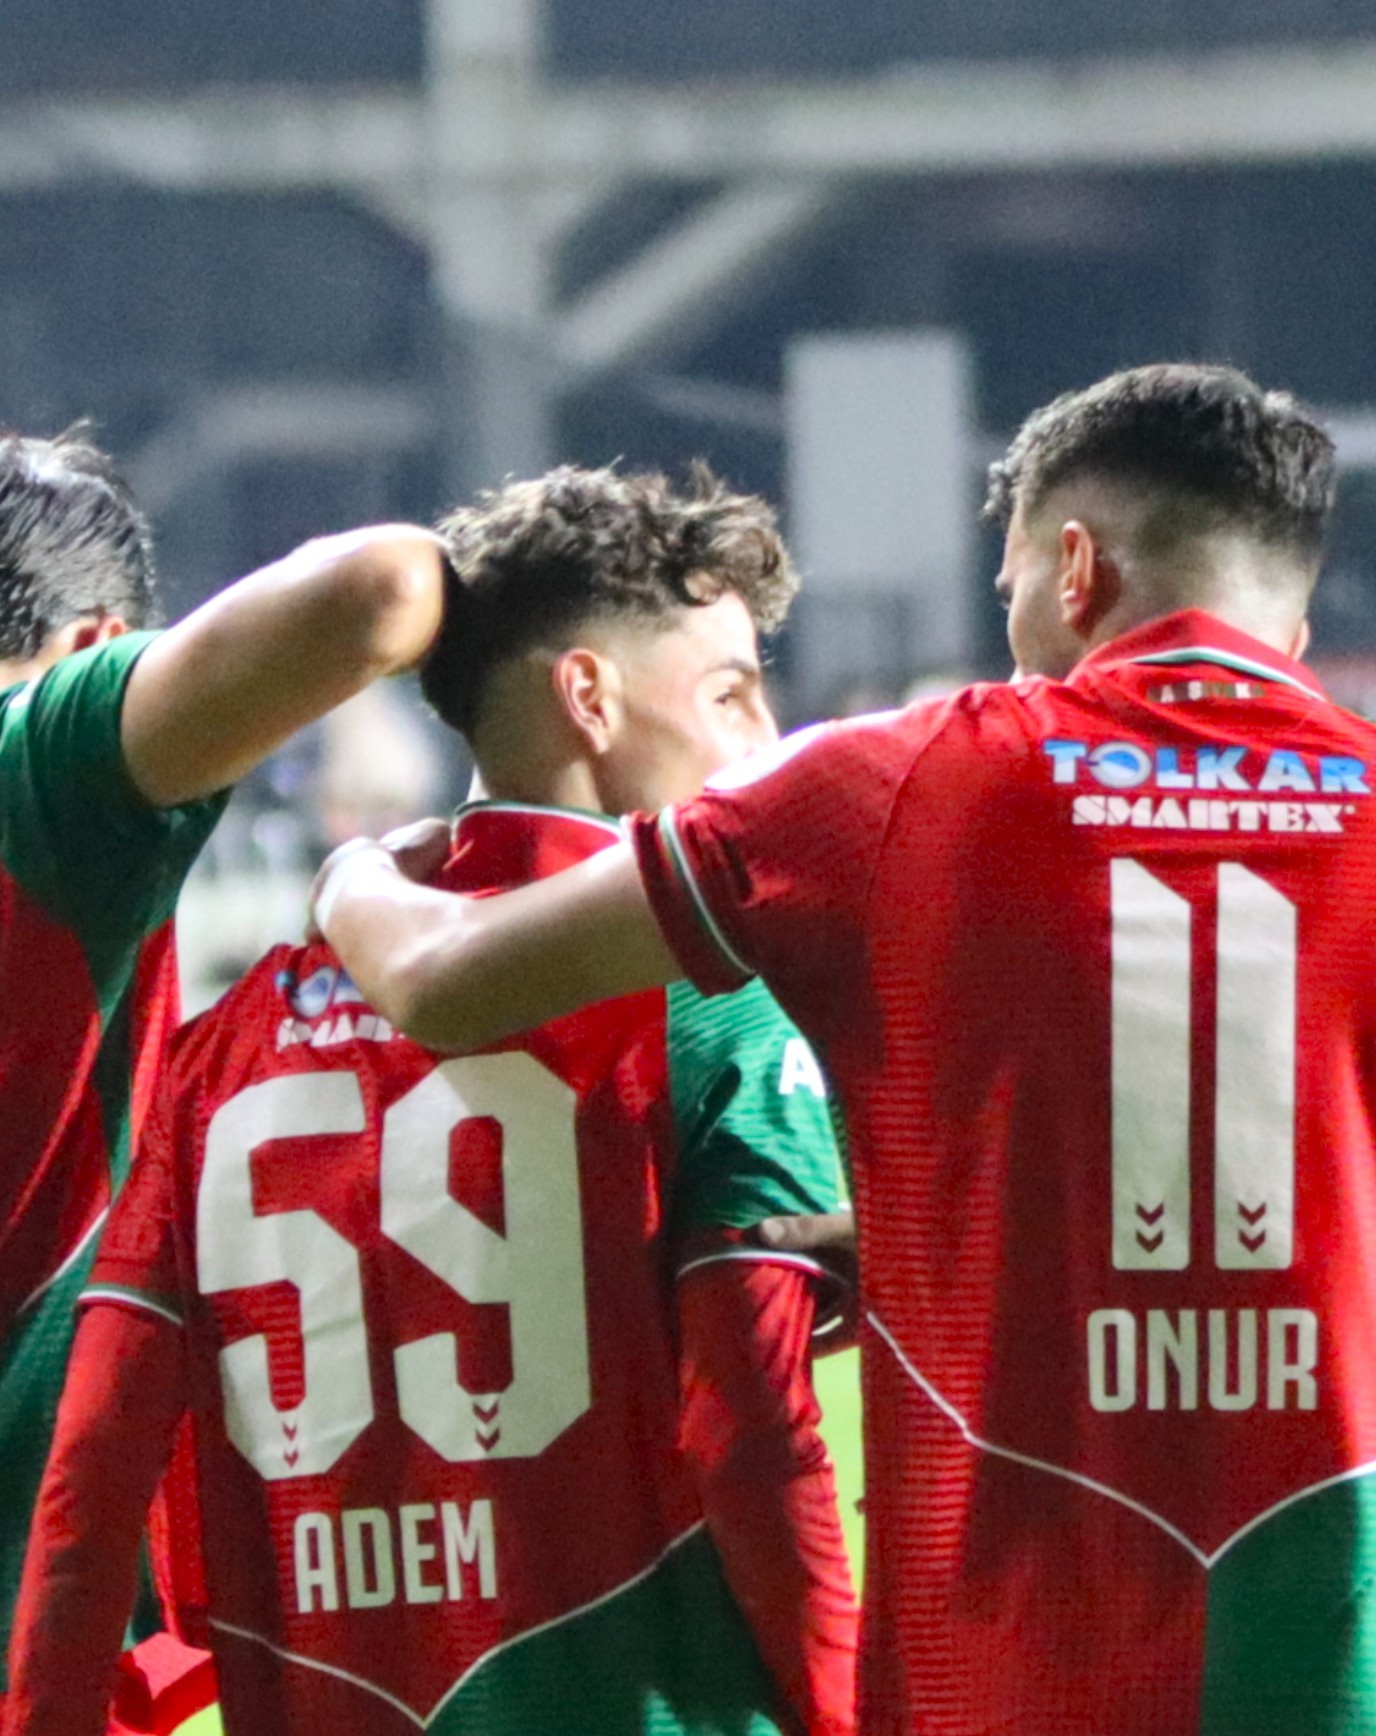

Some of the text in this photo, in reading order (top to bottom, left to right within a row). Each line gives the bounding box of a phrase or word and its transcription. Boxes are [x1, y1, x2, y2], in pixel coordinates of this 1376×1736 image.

[1043, 739, 1372, 794] TOLKAR
[1071, 794, 1355, 833] SMARTEX
[1110, 857, 1297, 1271] 11
[196, 1050, 592, 1481] 59
[1086, 1307, 1319, 1413] ONUR
[292, 1499, 499, 1614] ADEM
